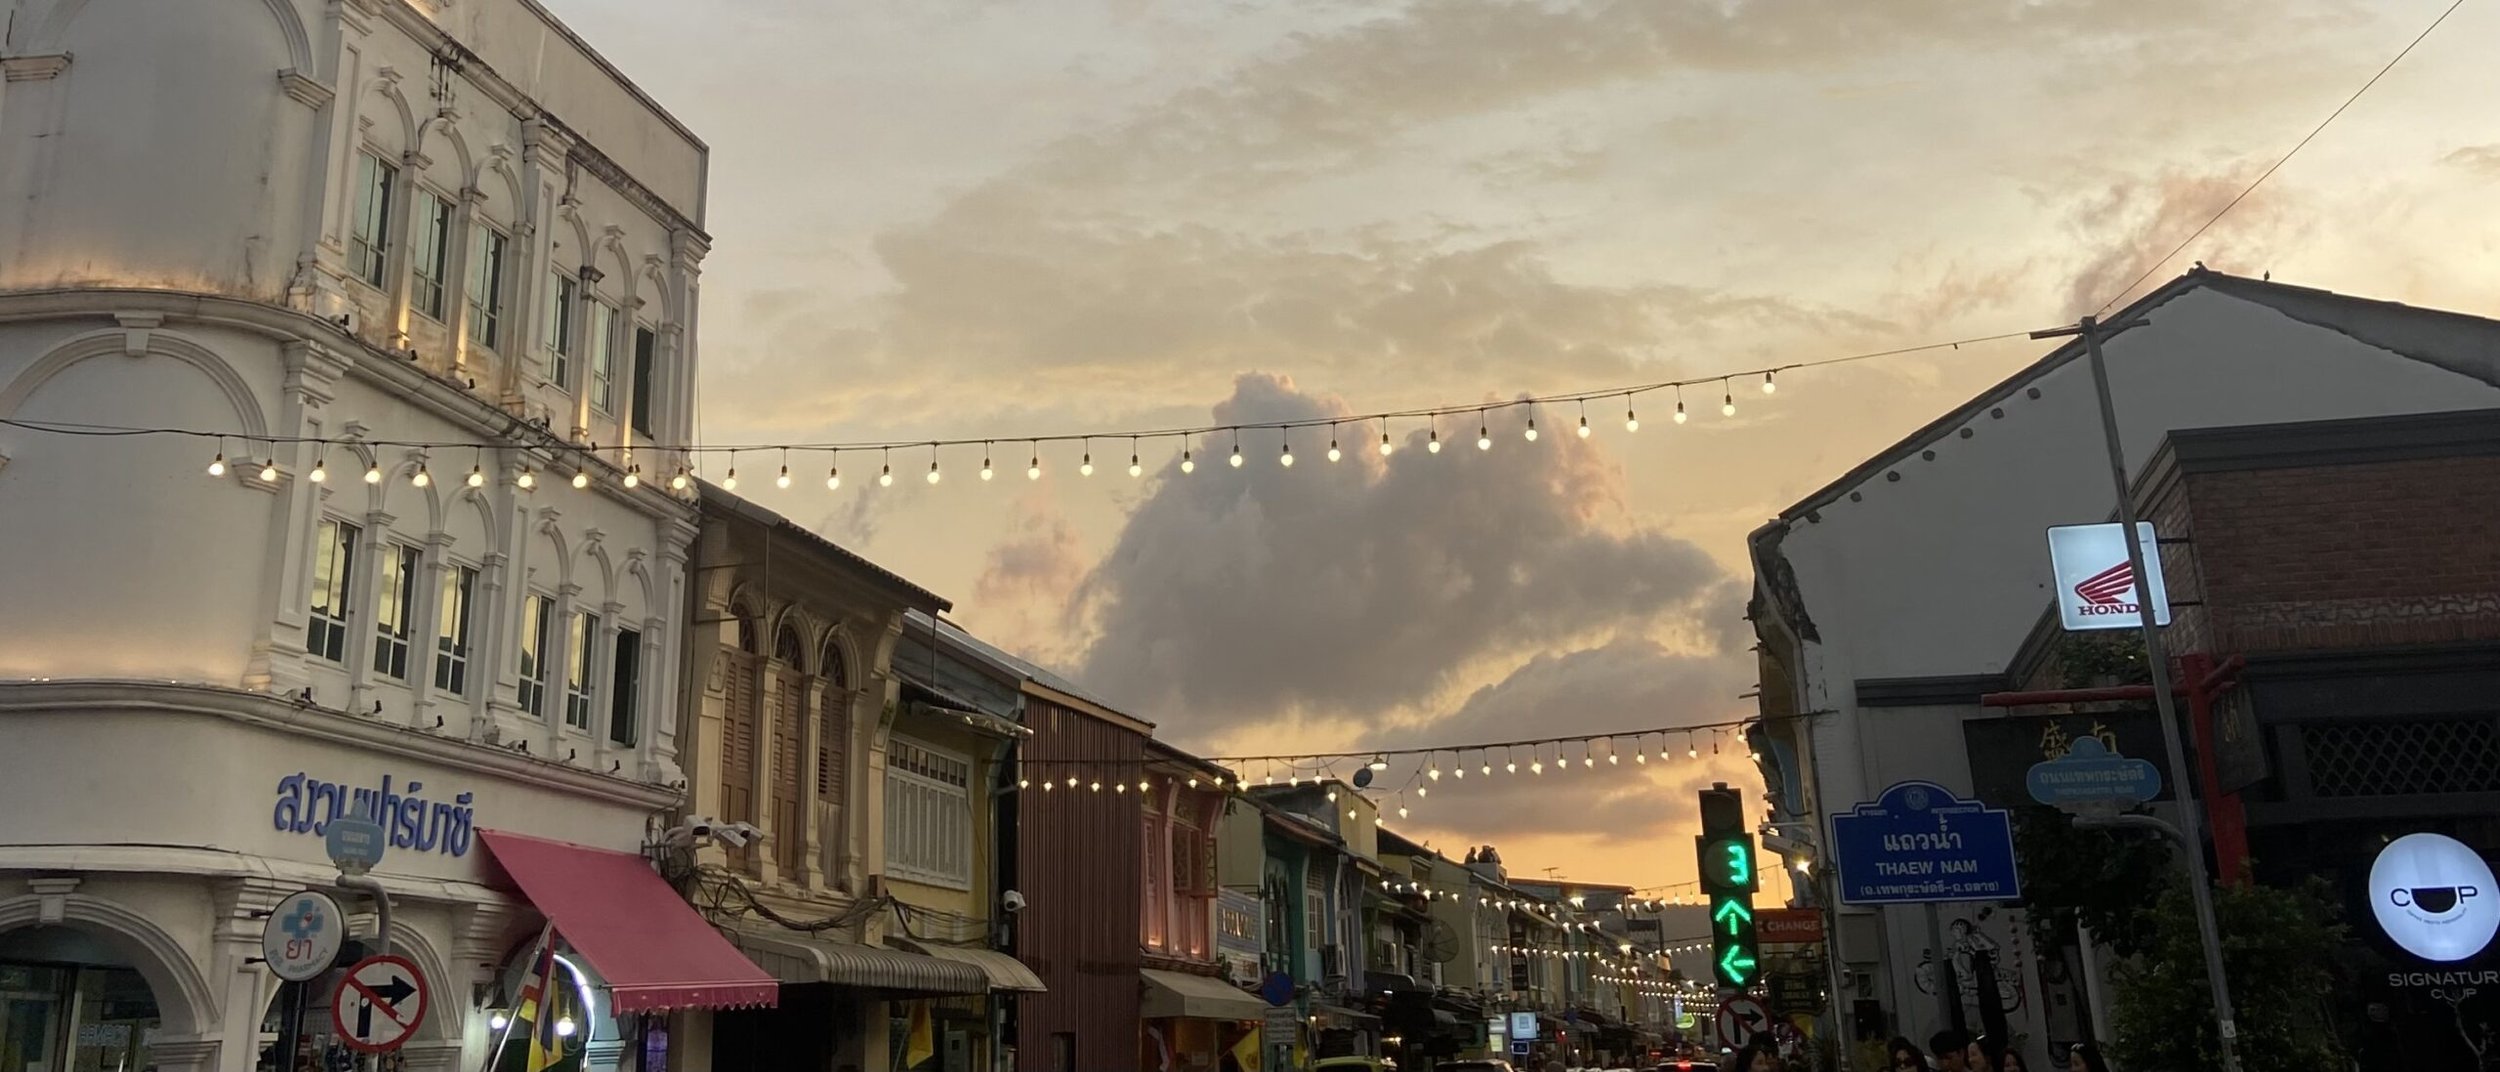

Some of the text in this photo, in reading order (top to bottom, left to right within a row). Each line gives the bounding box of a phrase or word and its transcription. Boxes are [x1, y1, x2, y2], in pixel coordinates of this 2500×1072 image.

[2078, 603, 2141, 616] HOND
[1883, 813, 1962, 852] แถวน้ำ
[1728, 845, 1750, 885] 3
[1875, 859, 1978, 876] THAEW NAM
[285, 938, 313, 960] ยา
[2388, 970, 2500, 988] SIGNATUR
